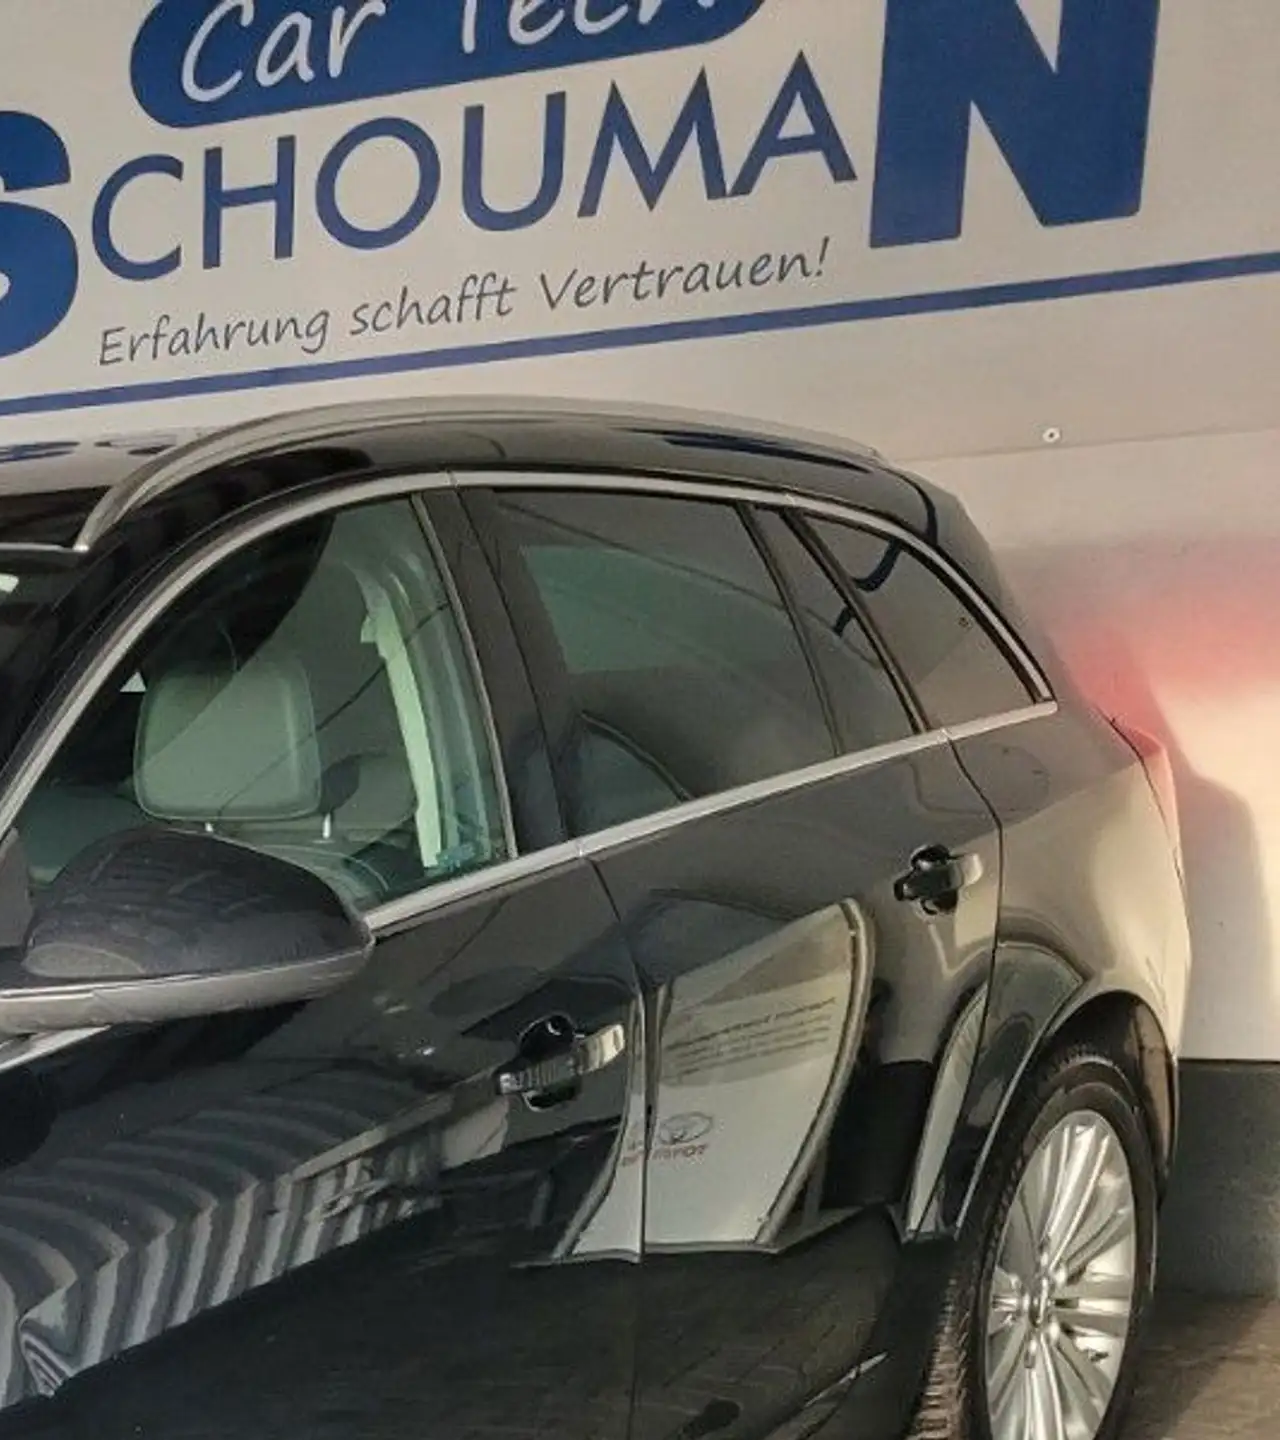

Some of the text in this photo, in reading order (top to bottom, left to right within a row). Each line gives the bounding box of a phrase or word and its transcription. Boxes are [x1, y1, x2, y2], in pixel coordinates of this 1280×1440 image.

[181, 0, 386, 102] Car
[98, 236, 830, 367] Erfahrung schafft Vertrauen!
